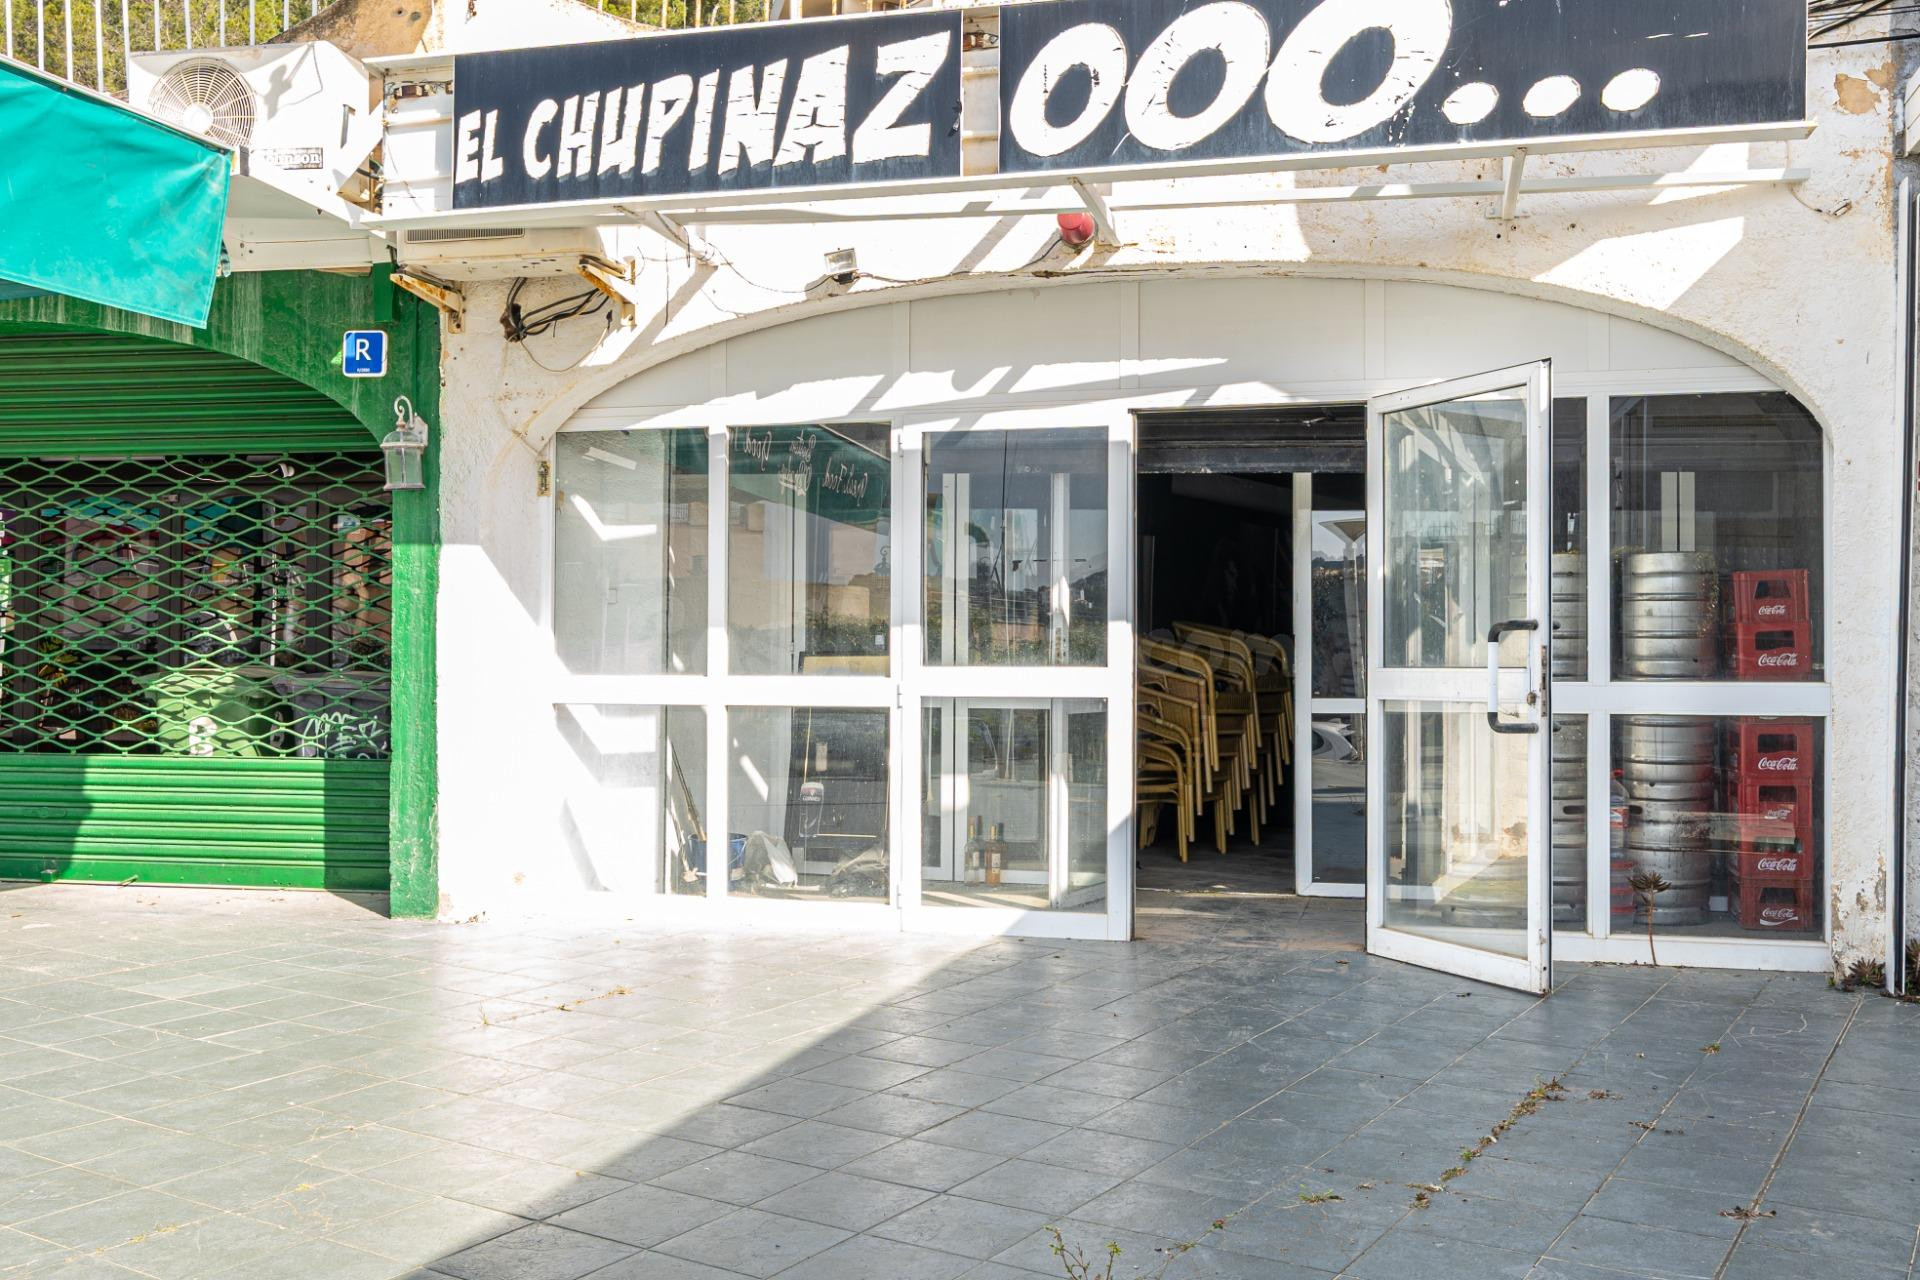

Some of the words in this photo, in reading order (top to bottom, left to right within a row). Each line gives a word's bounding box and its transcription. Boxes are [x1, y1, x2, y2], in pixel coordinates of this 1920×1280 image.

[455, 108, 504, 185] EL
[522, 30, 951, 181] CHUPINAZ
[355, 338, 372, 361] R
